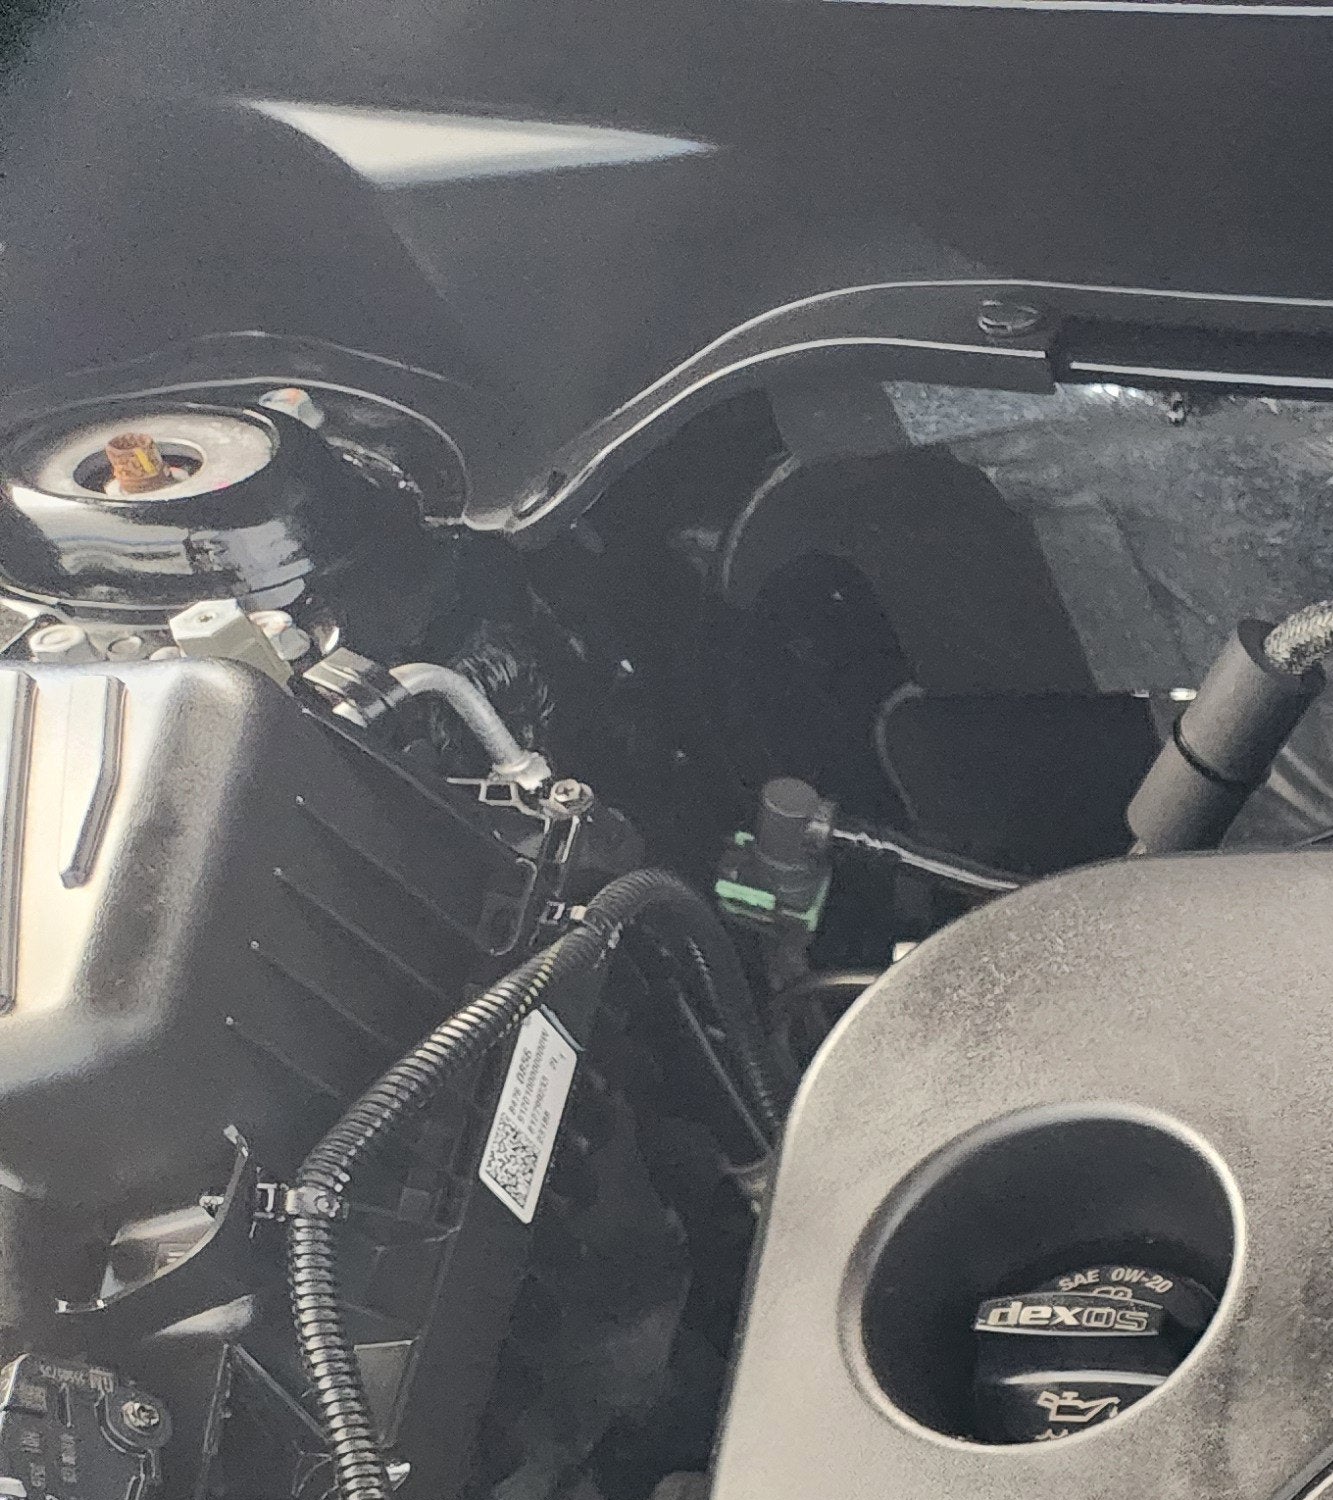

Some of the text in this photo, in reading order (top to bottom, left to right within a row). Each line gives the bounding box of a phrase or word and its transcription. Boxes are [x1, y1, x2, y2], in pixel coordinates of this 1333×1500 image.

[1058, 1267, 1174, 1294] SAE 0W-20
[987, 1302, 1150, 1333] dexos
